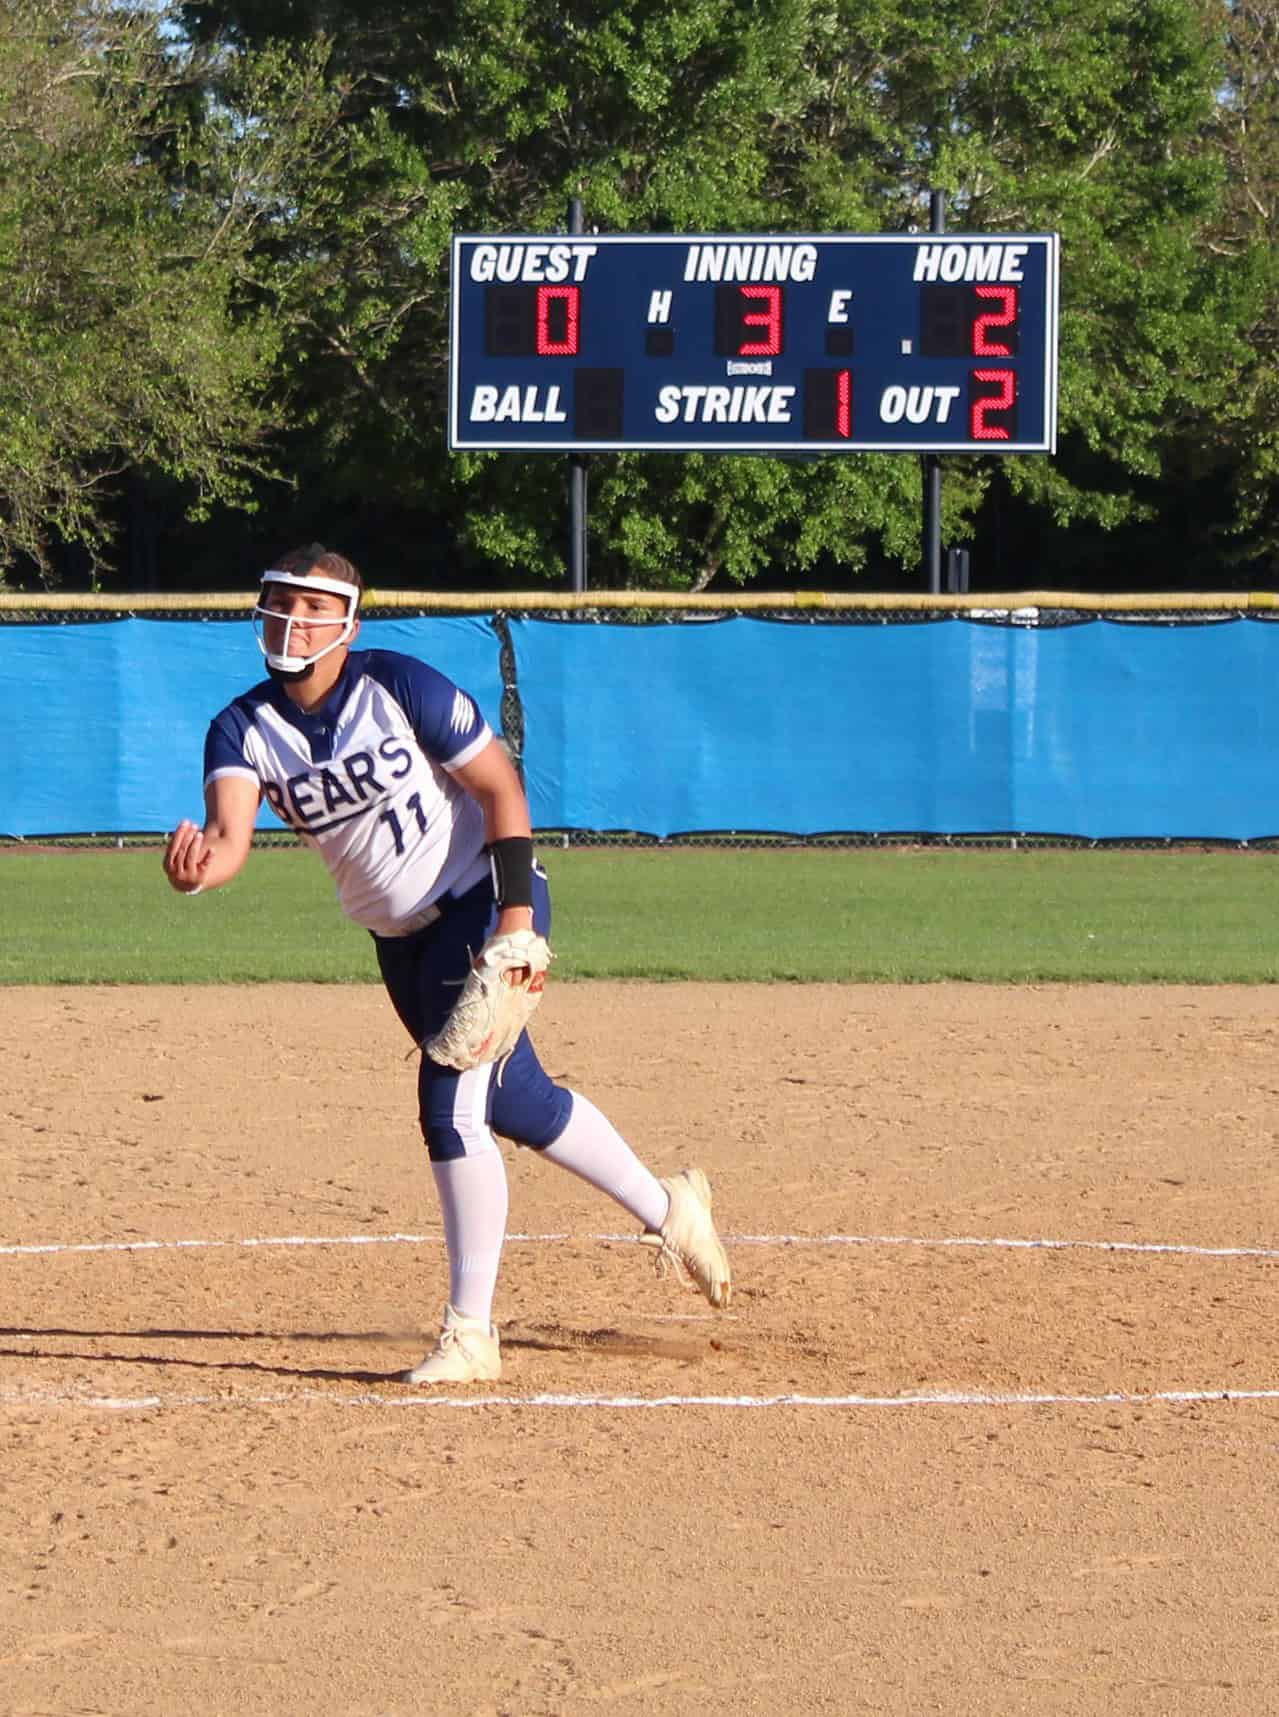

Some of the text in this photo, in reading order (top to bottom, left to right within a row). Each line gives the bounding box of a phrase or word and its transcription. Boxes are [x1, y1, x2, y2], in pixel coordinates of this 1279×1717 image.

[470, 245, 597, 282] GUEST
[684, 245, 817, 282] INNING
[913, 245, 1028, 282] HOME
[537, 285, 579, 355] 0
[648, 290, 672, 323] H
[739, 285, 783, 355] 3
[828, 290, 852, 323] E
[973, 285, 1017, 356] 2
[470, 386, 566, 422] BALL
[655, 386, 796, 423] STRIKE
[837, 370, 852, 438] 1
[880, 386, 960, 423] OUT
[972, 369, 1015, 439] 2
[380, 791, 428, 857] 11
